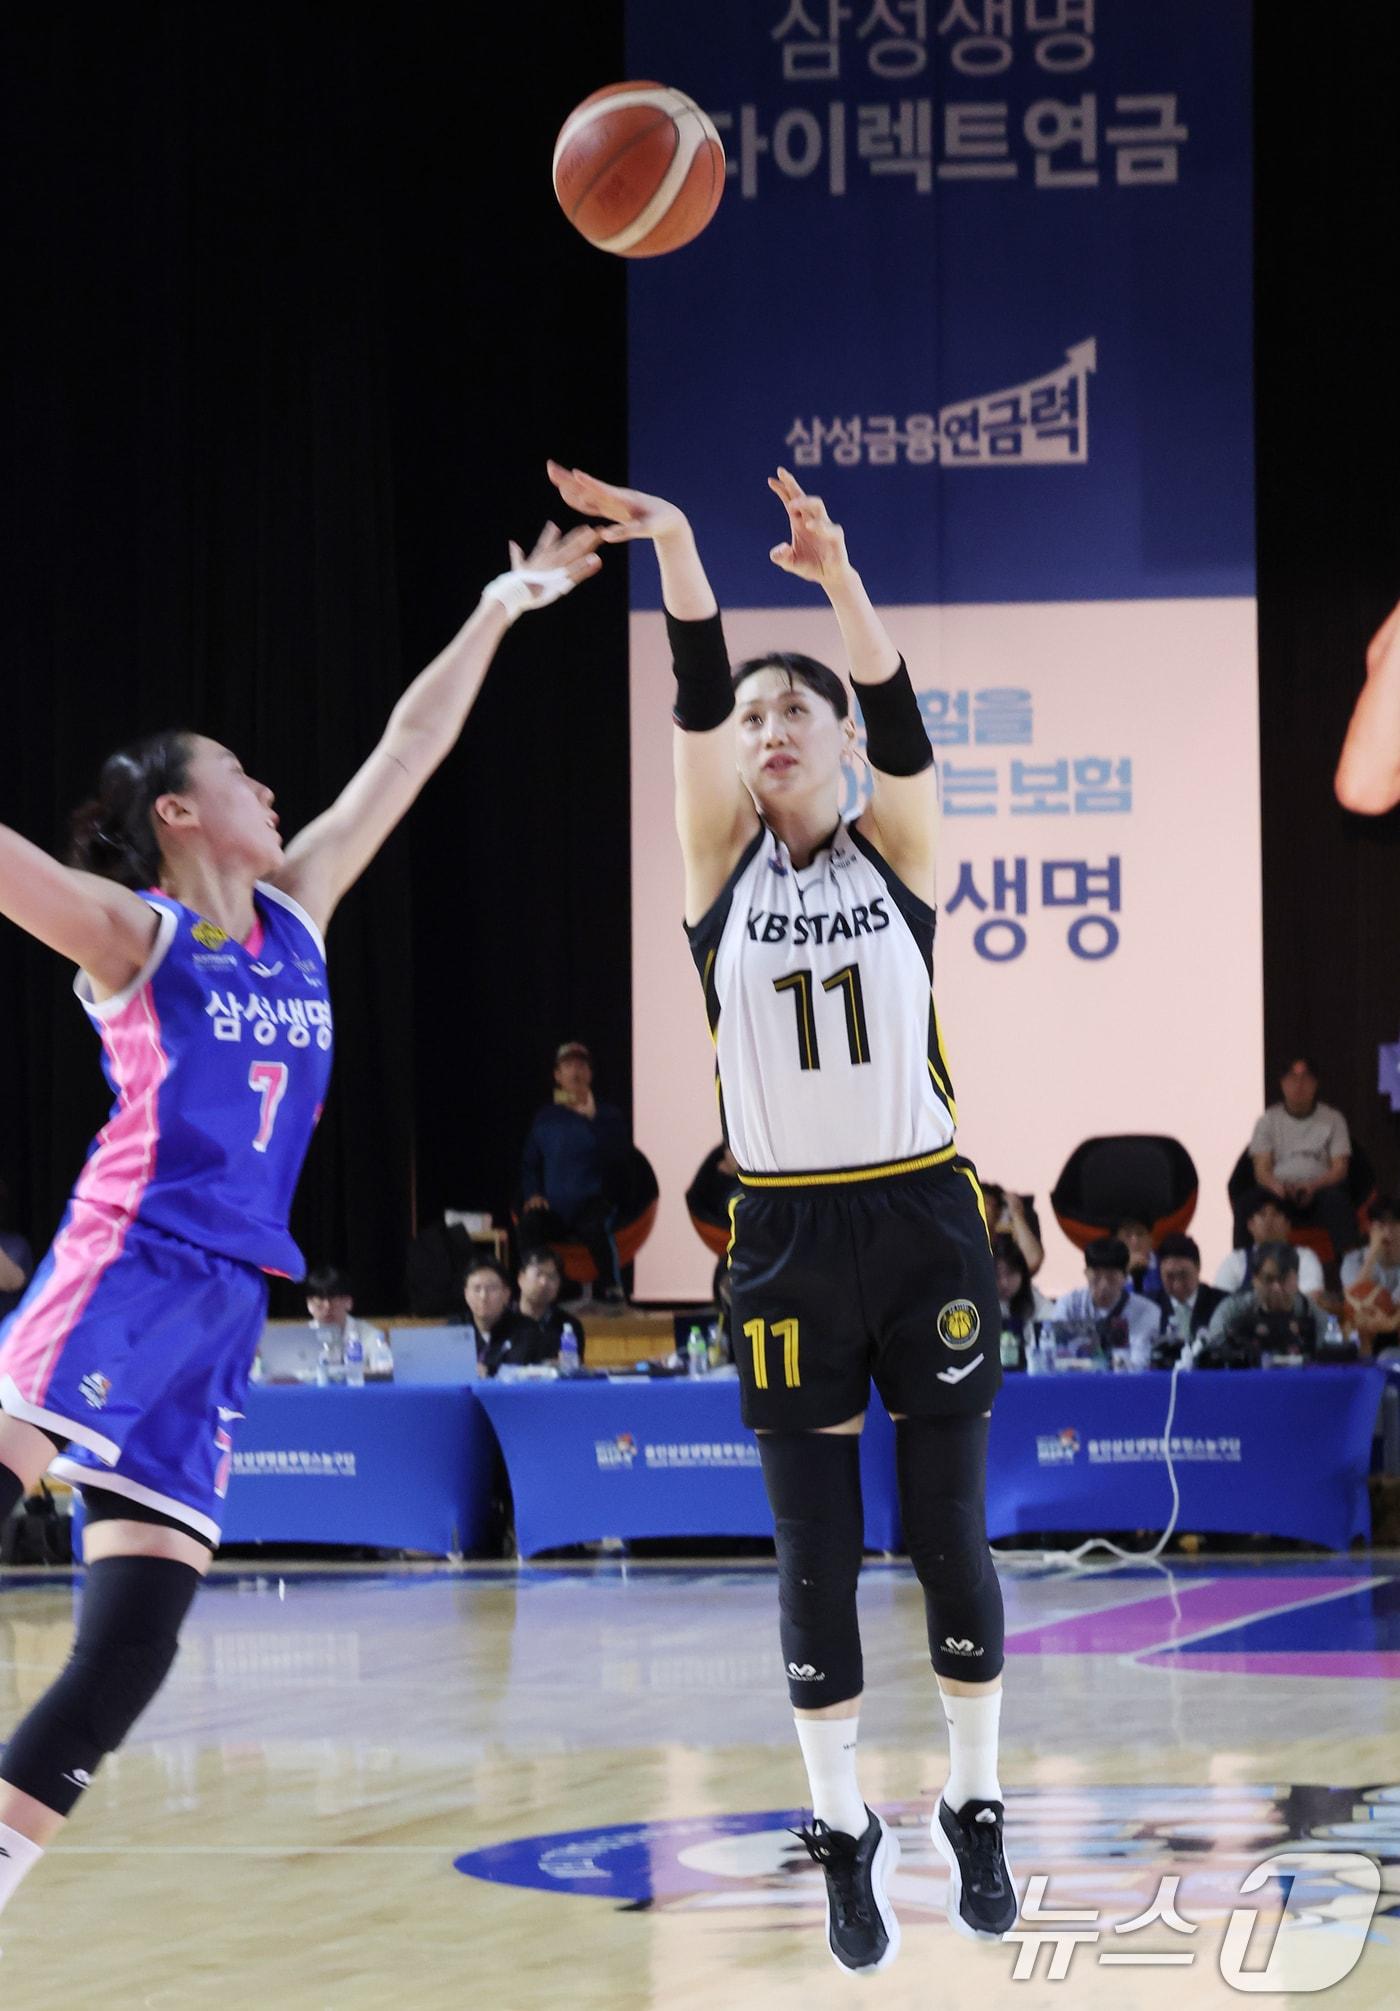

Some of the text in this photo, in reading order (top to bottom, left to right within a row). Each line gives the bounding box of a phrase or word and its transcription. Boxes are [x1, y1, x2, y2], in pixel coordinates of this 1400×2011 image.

[772, 0, 1095, 80] 삼성생명
[712, 93, 1189, 198] 다이렉트연금
[205, 990, 333, 1051] 삼성생명
[772, 962, 871, 1072] 11
[249, 1060, 289, 1153] 7
[743, 1318, 801, 1390] 11
